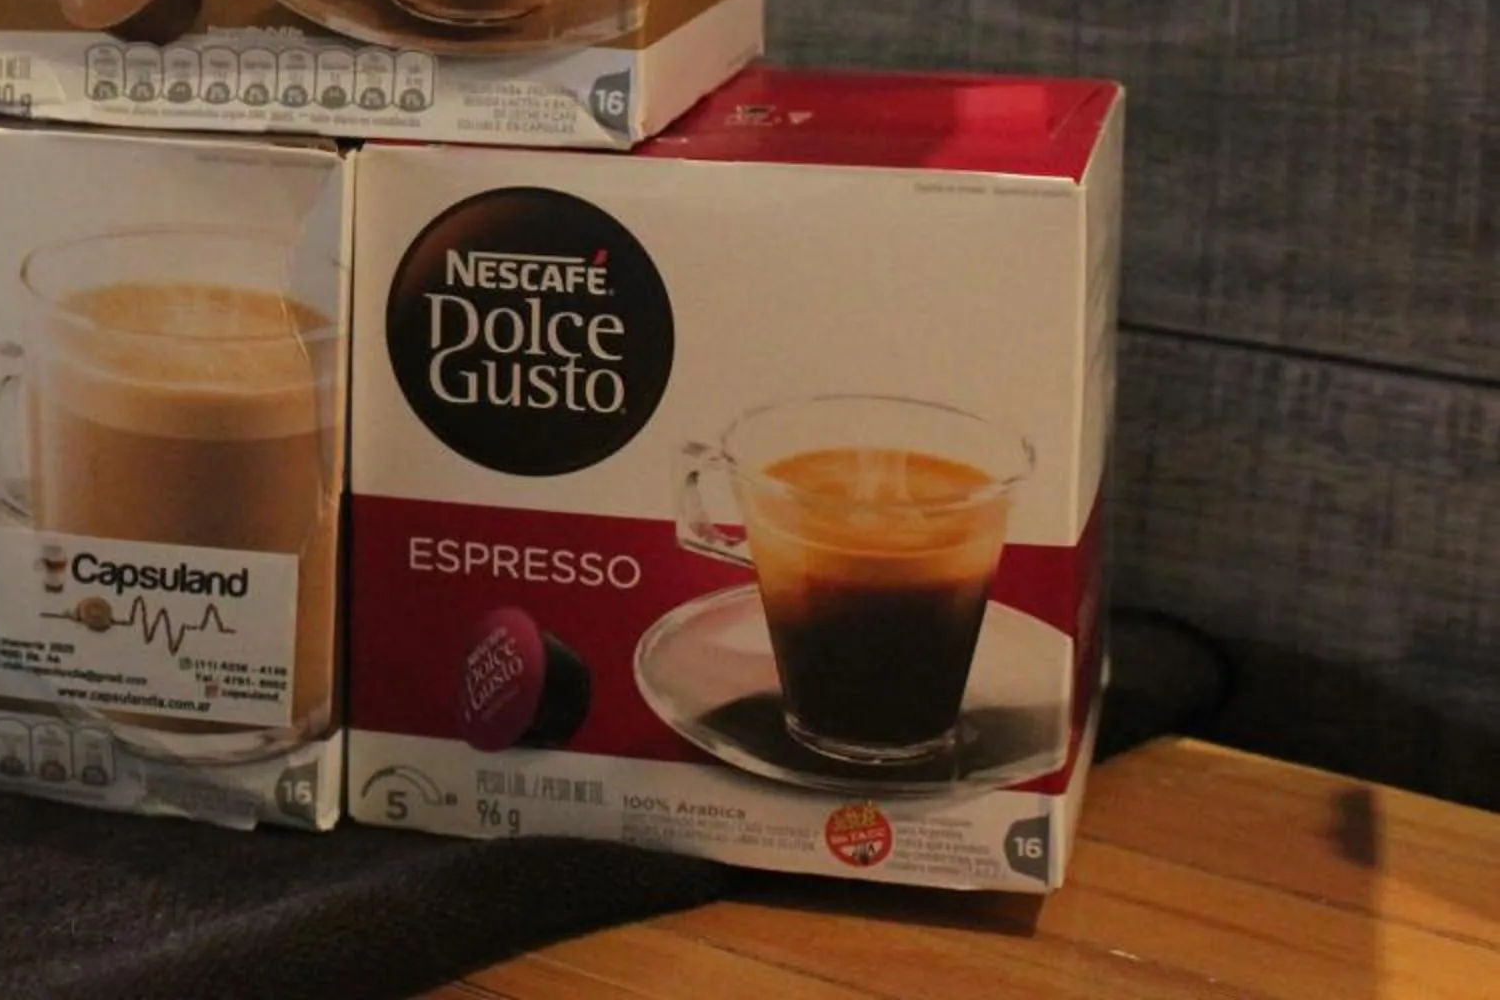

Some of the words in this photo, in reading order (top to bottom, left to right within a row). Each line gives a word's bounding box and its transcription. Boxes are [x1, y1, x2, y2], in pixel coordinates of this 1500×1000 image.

[594, 89, 626, 116] 16
[423, 292, 626, 361] Dolce
[428, 353, 627, 414] Gusto
[71, 552, 249, 598] Capsuland
[408, 536, 642, 589] ESPRESSO
[282, 779, 313, 805] 16
[386, 791, 408, 820] 5
[476, 798, 502, 827] 96
[1014, 836, 1042, 860] 16
